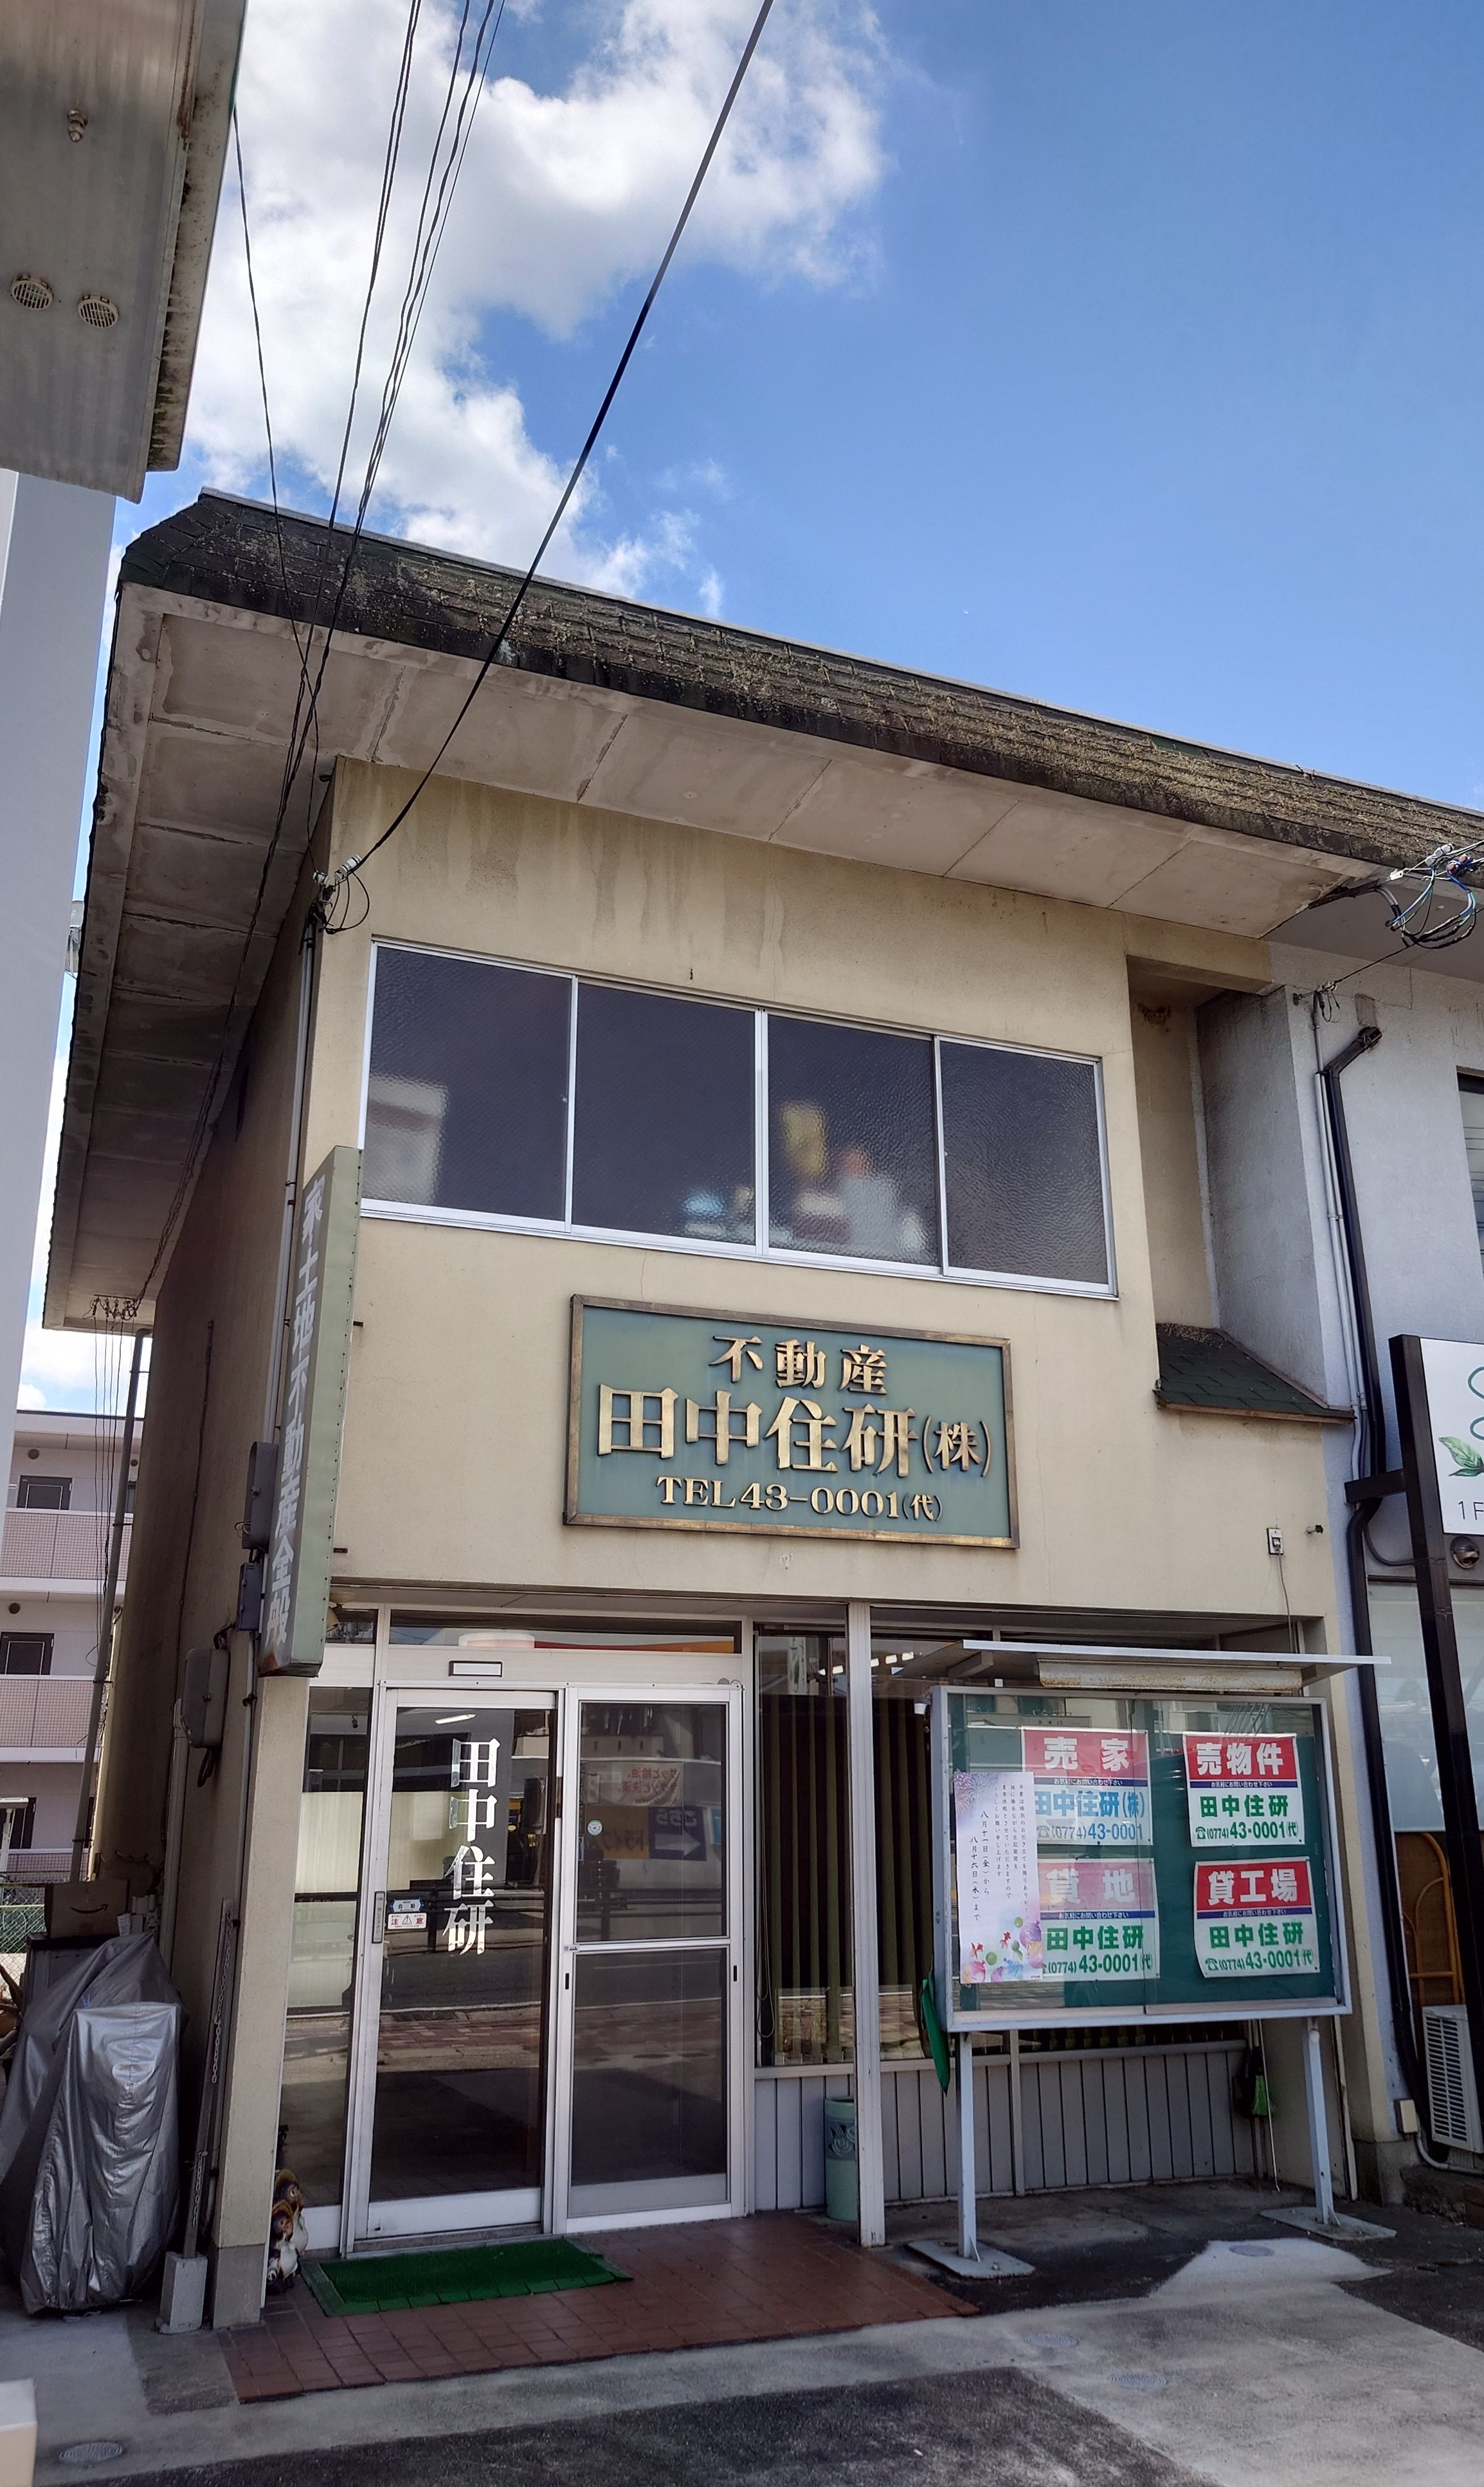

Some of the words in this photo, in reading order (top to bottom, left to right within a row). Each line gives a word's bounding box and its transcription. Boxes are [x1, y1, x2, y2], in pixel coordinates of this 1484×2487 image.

[709, 1335, 888, 1395] 不動産
[265, 1174, 326, 1650] 家土地不動産全般
[597, 1383, 991, 1478] 田中住研(株)
[1196, 1742, 1283, 1775] 売物件
[1200, 1794, 1289, 1817] 田中住研
[442, 1738, 500, 1955] 田中住研
[1208, 1868, 1298, 1906] 貸工場
[1047, 1925, 1143, 1951] 田中住研
[1209, 1922, 1303, 1949] 田中住研
